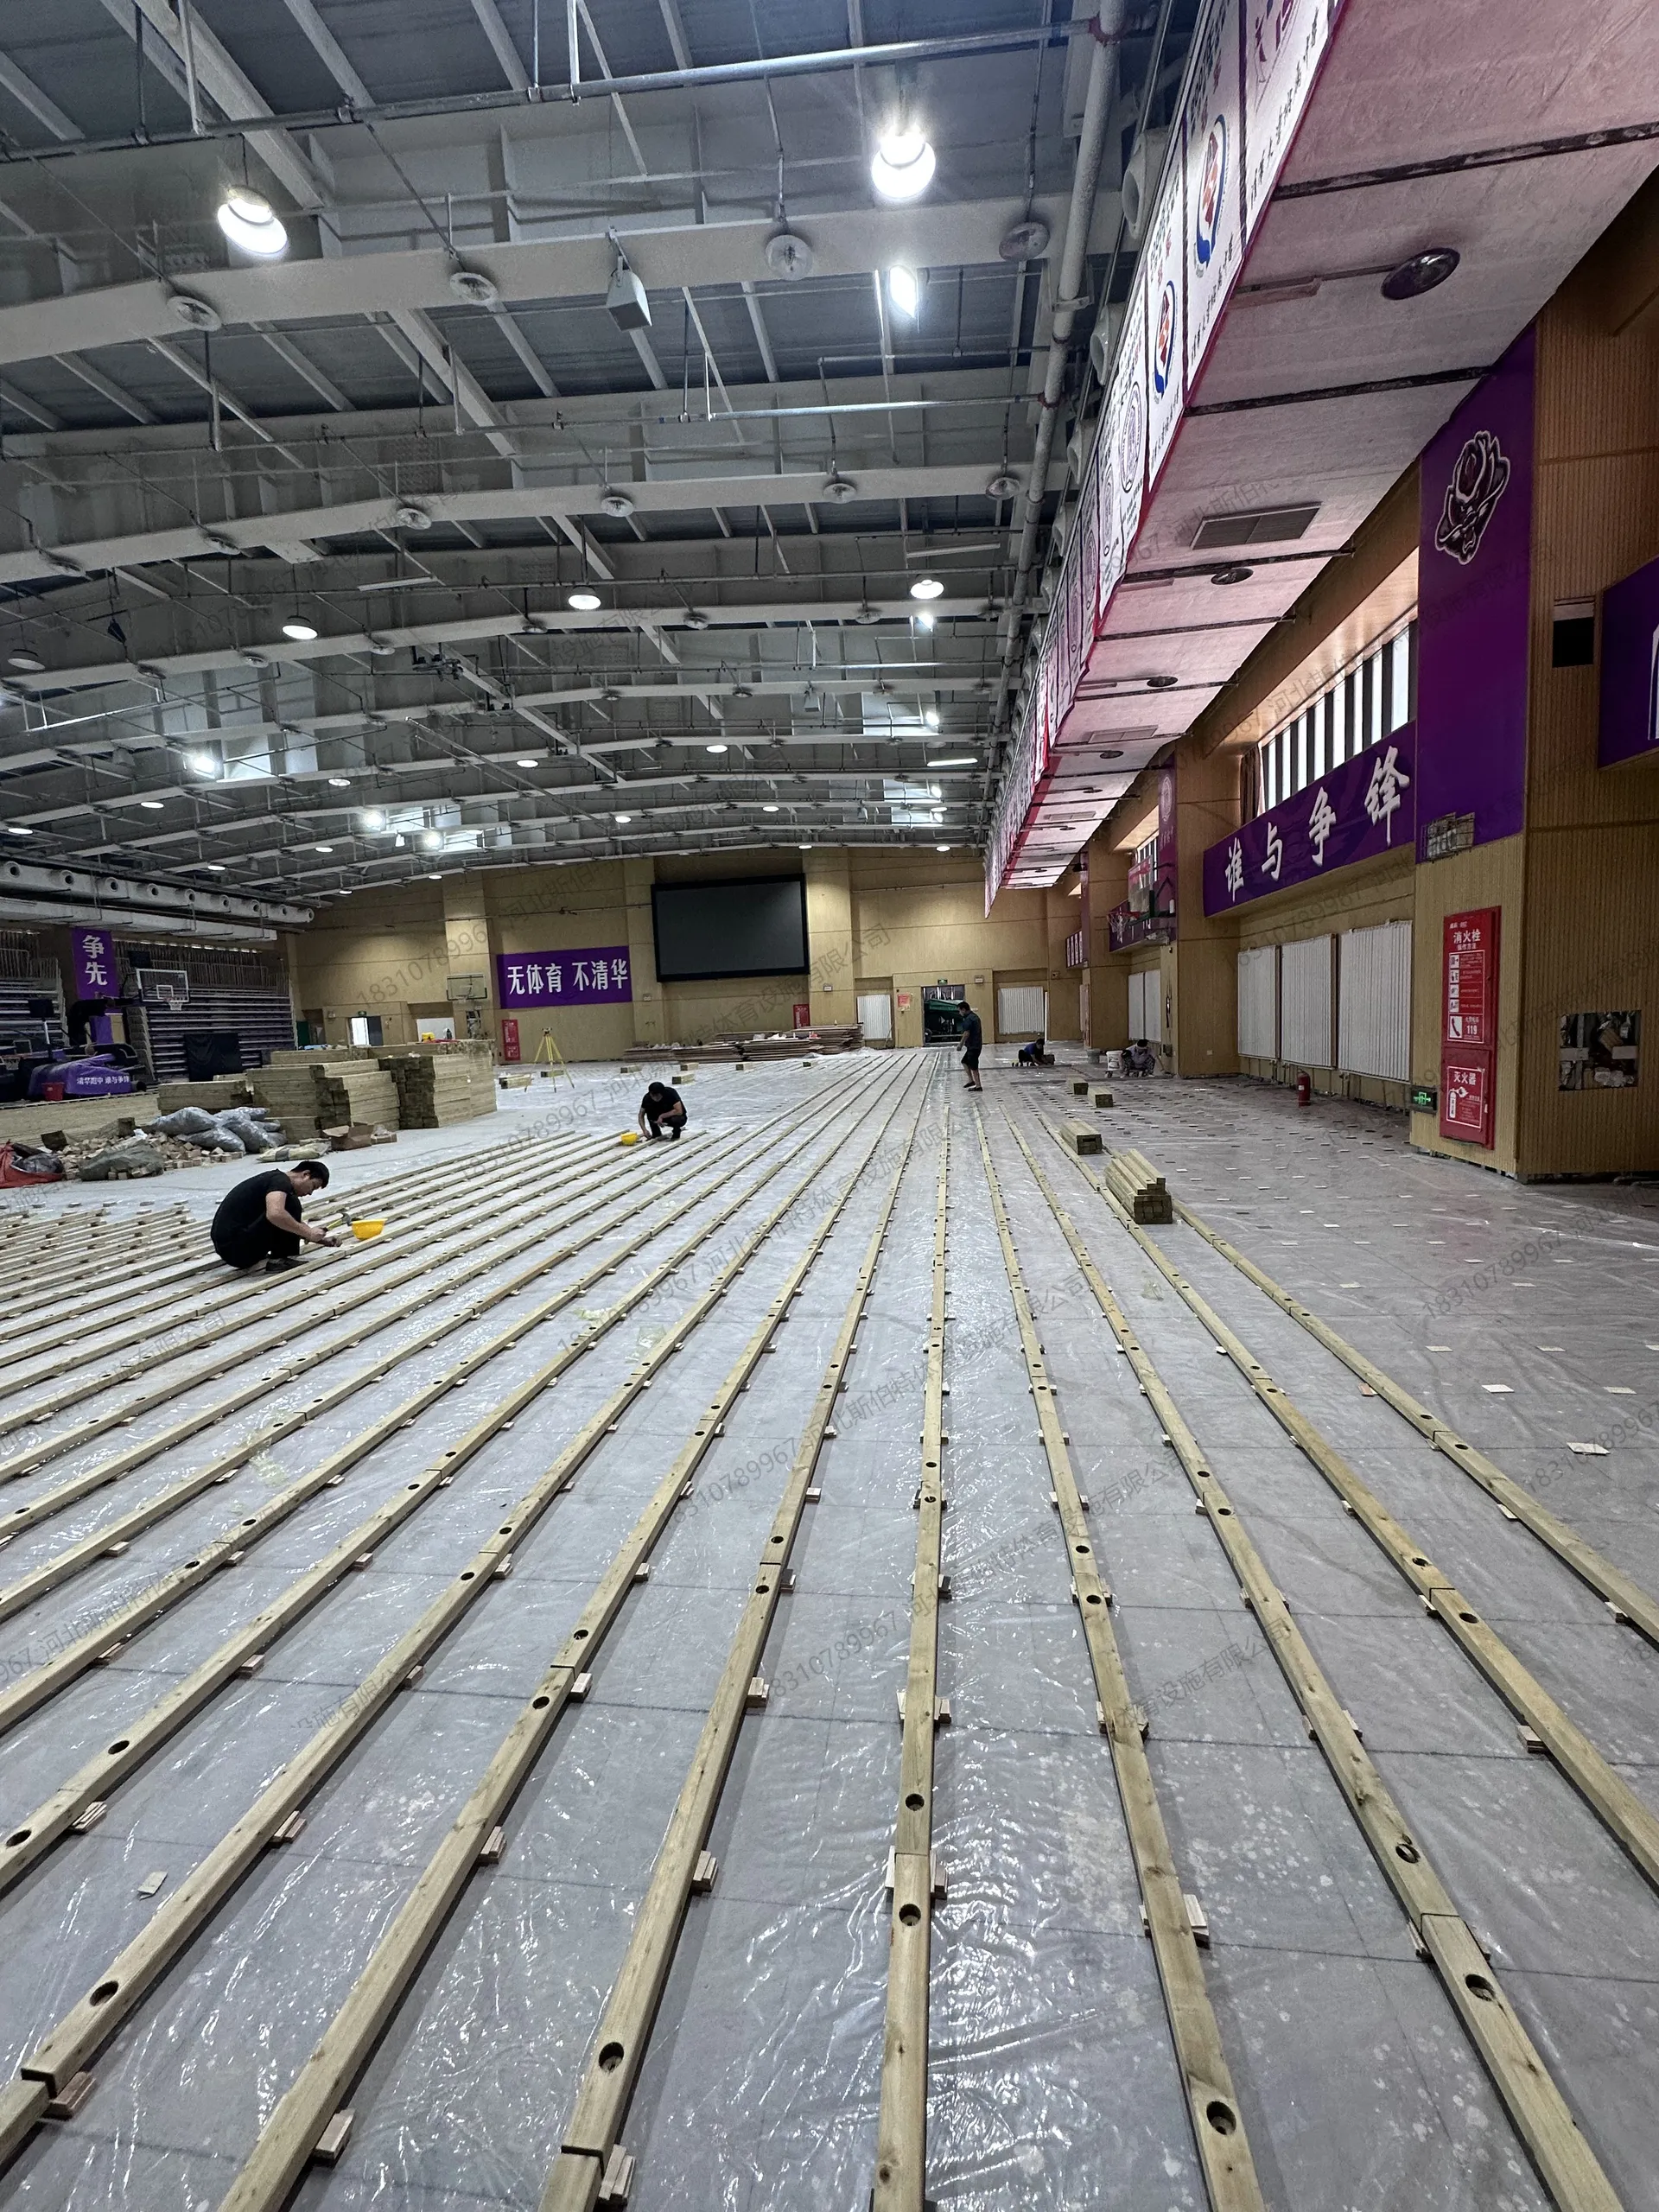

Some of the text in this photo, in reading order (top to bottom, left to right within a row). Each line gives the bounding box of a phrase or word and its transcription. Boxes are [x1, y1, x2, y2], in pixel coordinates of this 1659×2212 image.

[1224, 745, 1410, 903] 谁与争锋
[1453, 928, 1481, 944] 消火栓
[82, 935, 108, 986] 争先
[507, 958, 628, 995] 无体育 不清华
[1466, 1025, 1478, 1034] 119
[1453, 1071, 1476, 1085] 灭火器
